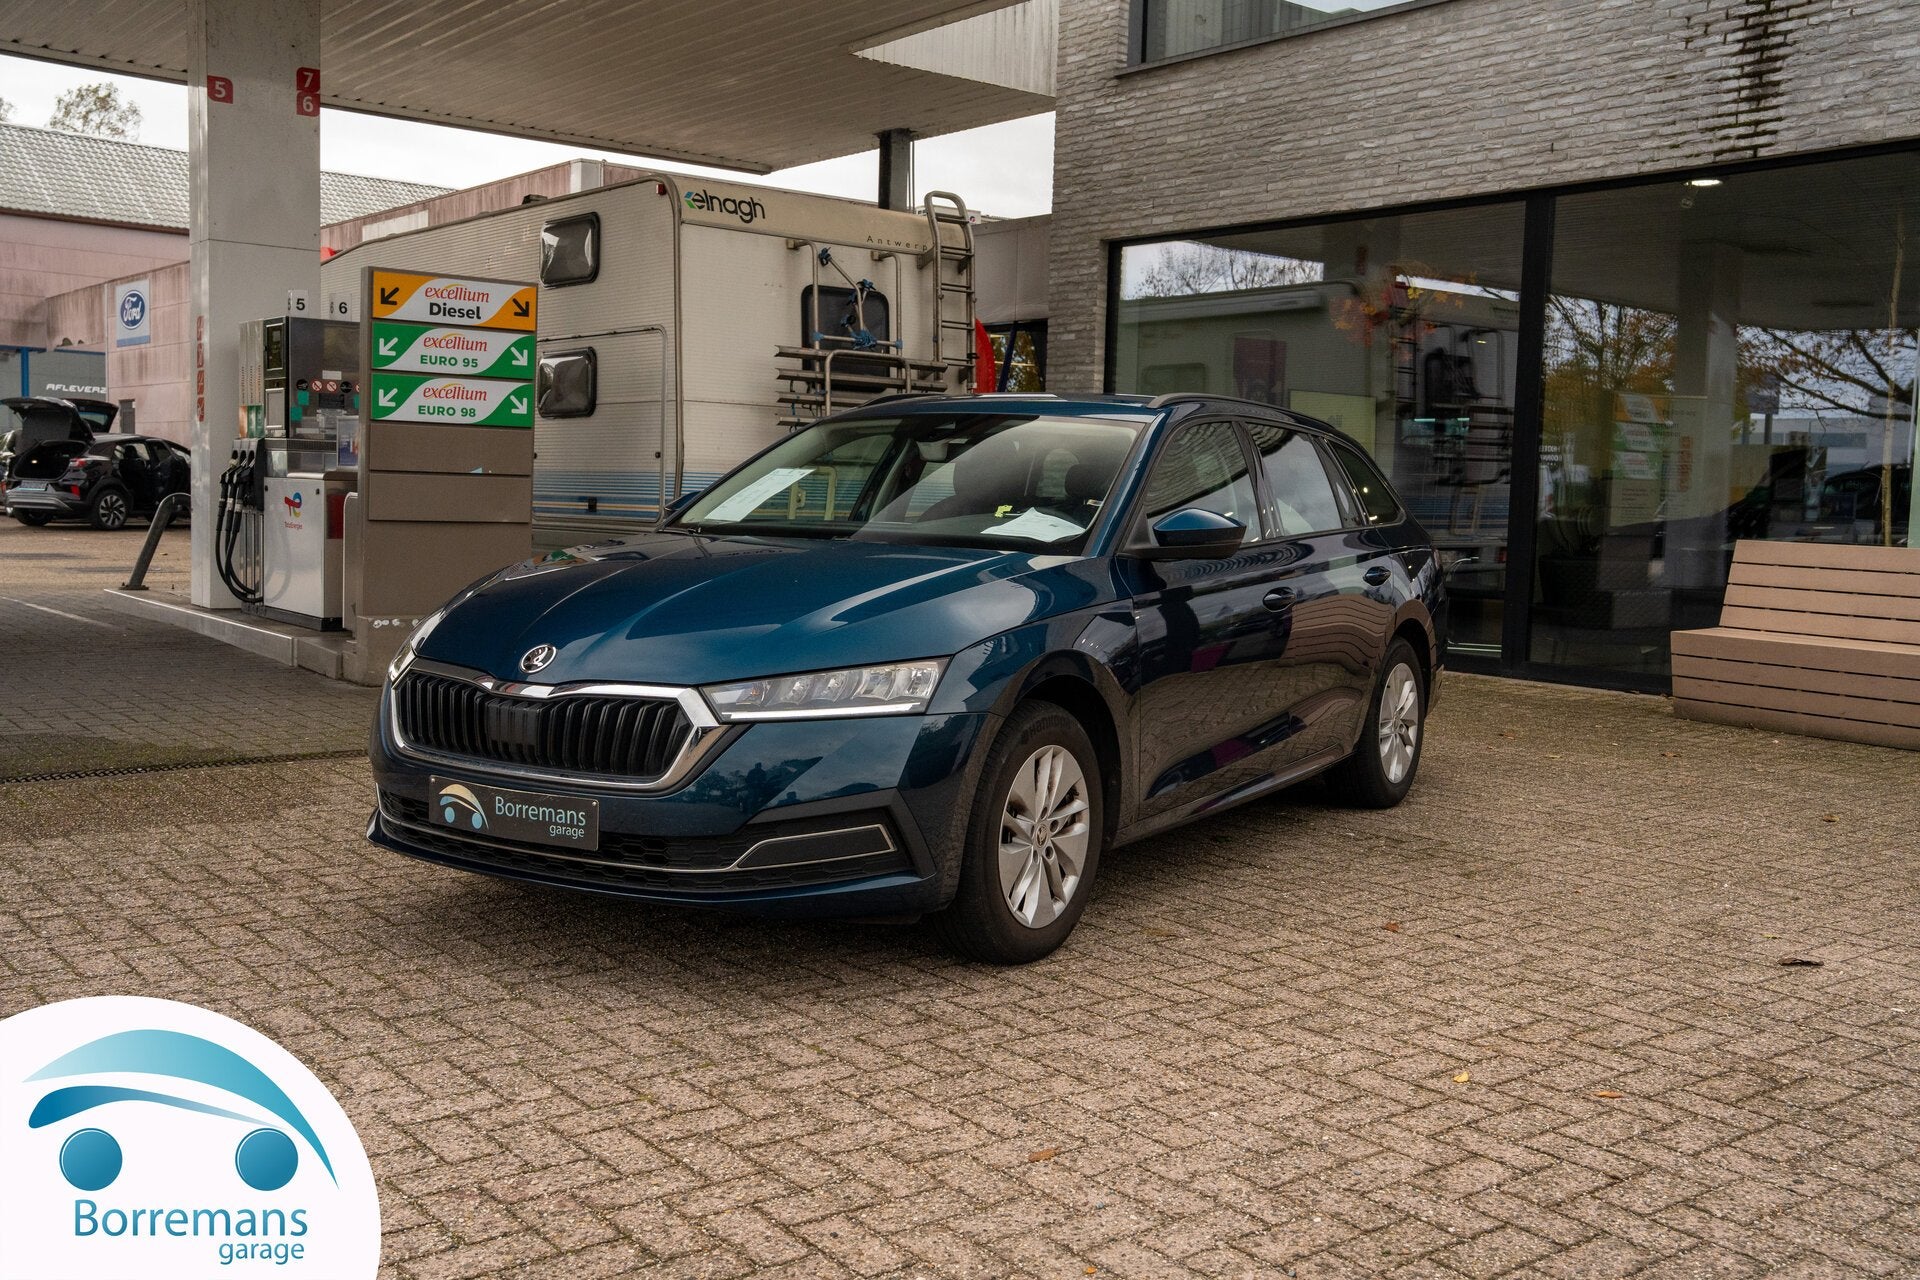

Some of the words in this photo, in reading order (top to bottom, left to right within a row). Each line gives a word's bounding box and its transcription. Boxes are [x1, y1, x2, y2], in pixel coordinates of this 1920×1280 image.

[302, 72, 314, 88] 7
[214, 81, 226, 98] 5
[302, 96, 314, 112] 6
[691, 189, 765, 223] elnagh
[867, 235, 928, 251] Antwerp
[424, 286, 490, 303] excellium
[123, 296, 142, 322] Ford
[296, 298, 305, 311] 5
[338, 302, 348, 314] 6
[429, 302, 482, 320] Diesel
[423, 335, 487, 352] excellium
[420, 355, 458, 367] EURO
[462, 357, 478, 368] 95
[423, 385, 487, 401] excellium
[418, 405, 456, 417] EURO
[460, 407, 476, 418] 98
[495, 796, 586, 826] Borremans
[549, 824, 585, 840] garage
